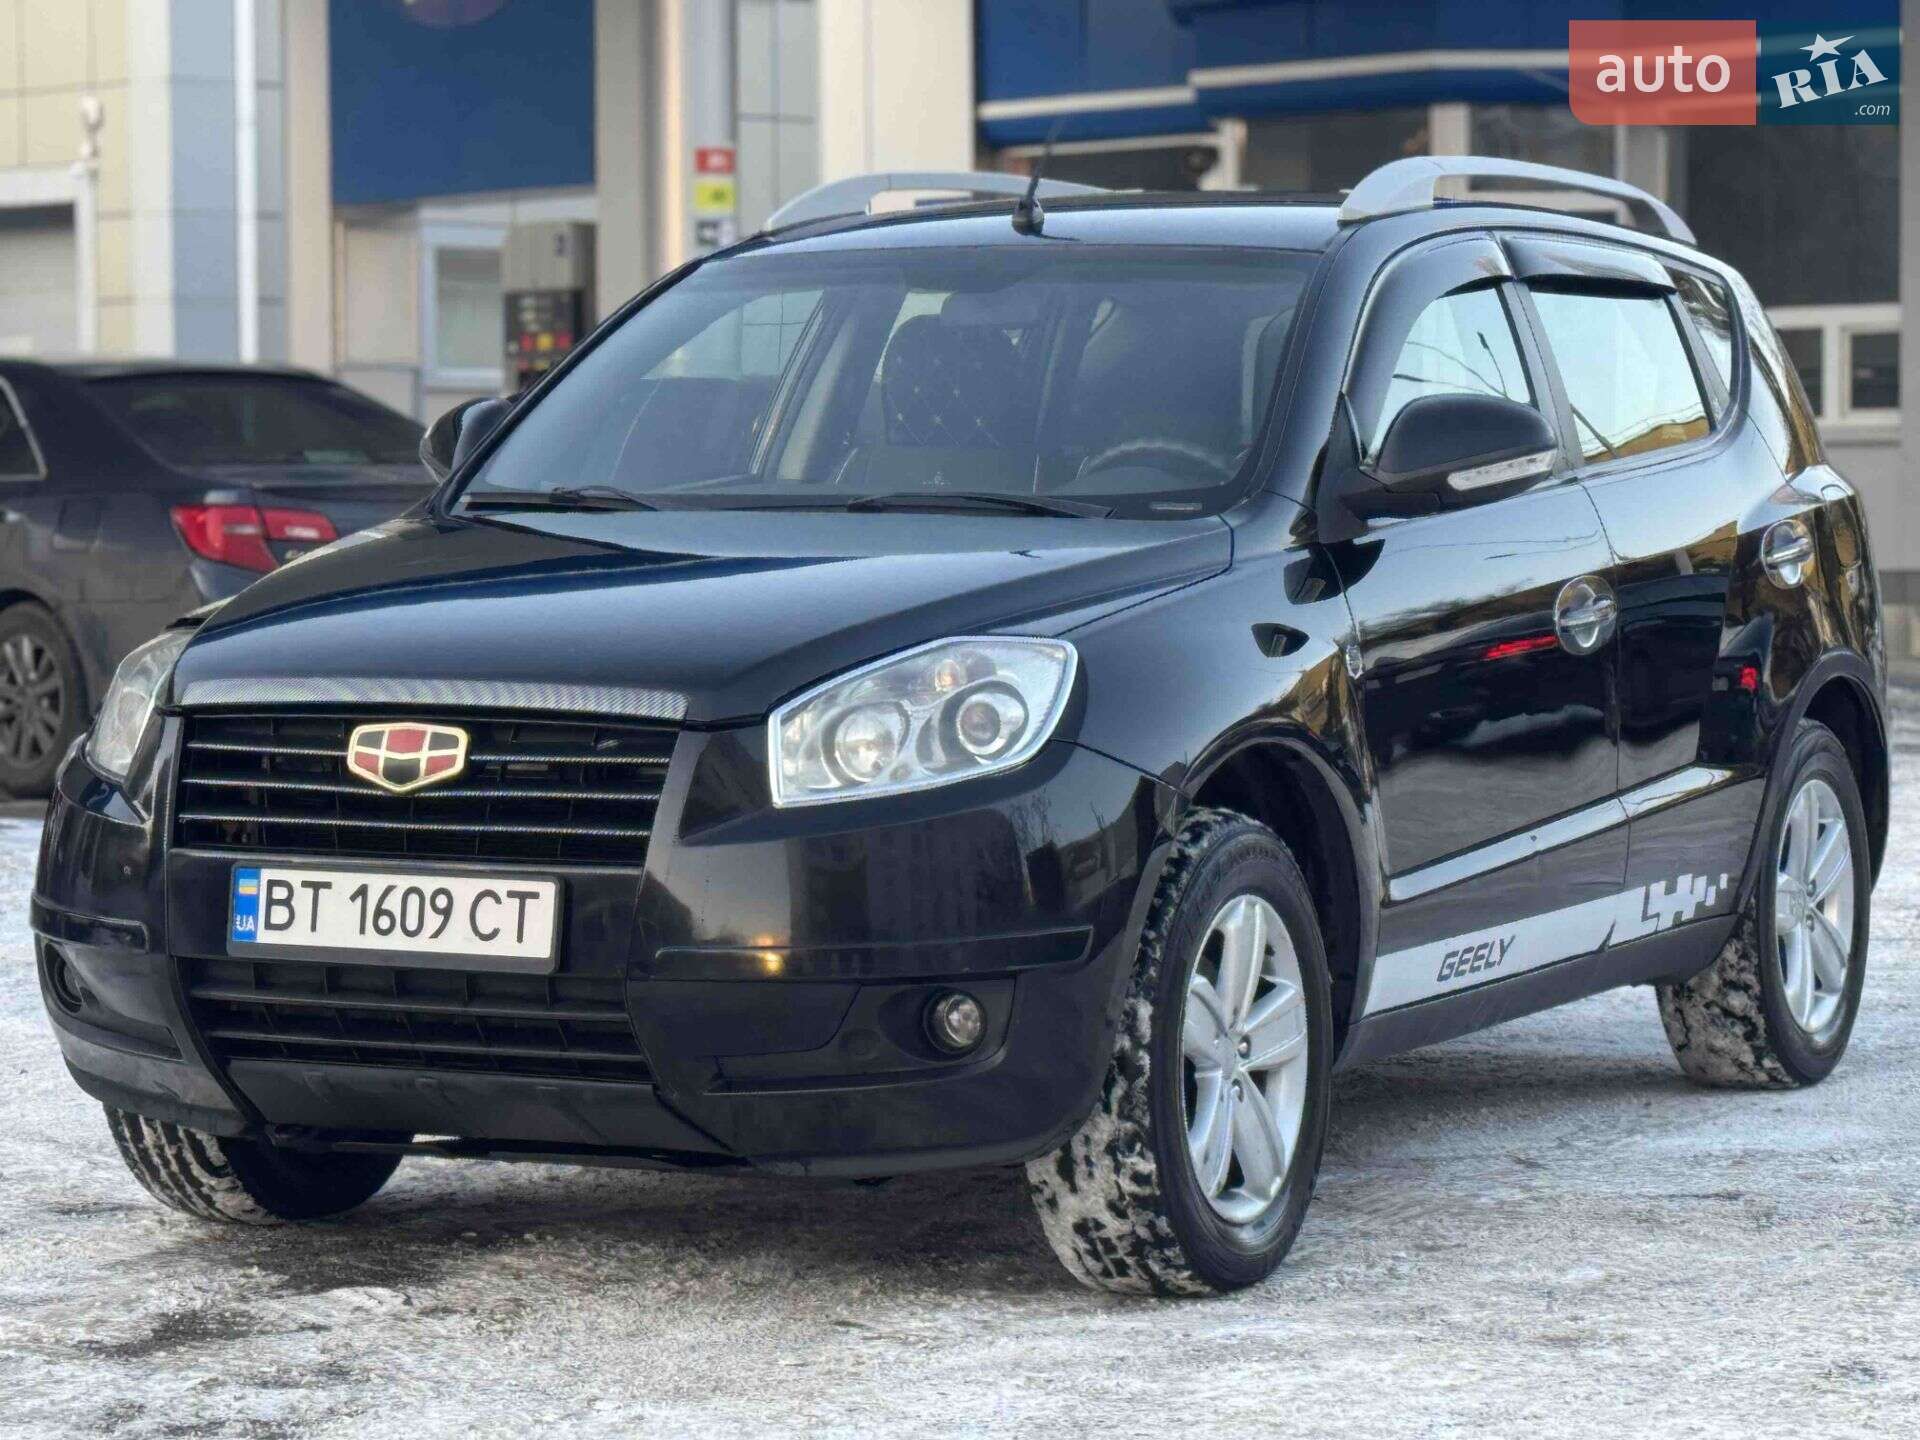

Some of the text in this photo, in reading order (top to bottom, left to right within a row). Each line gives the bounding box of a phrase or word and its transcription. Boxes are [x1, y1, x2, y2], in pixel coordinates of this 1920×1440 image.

[235, 913, 256, 932] UA
[263, 878, 541, 944] BT 1609 CT
[1437, 935, 1516, 982] GEELY
